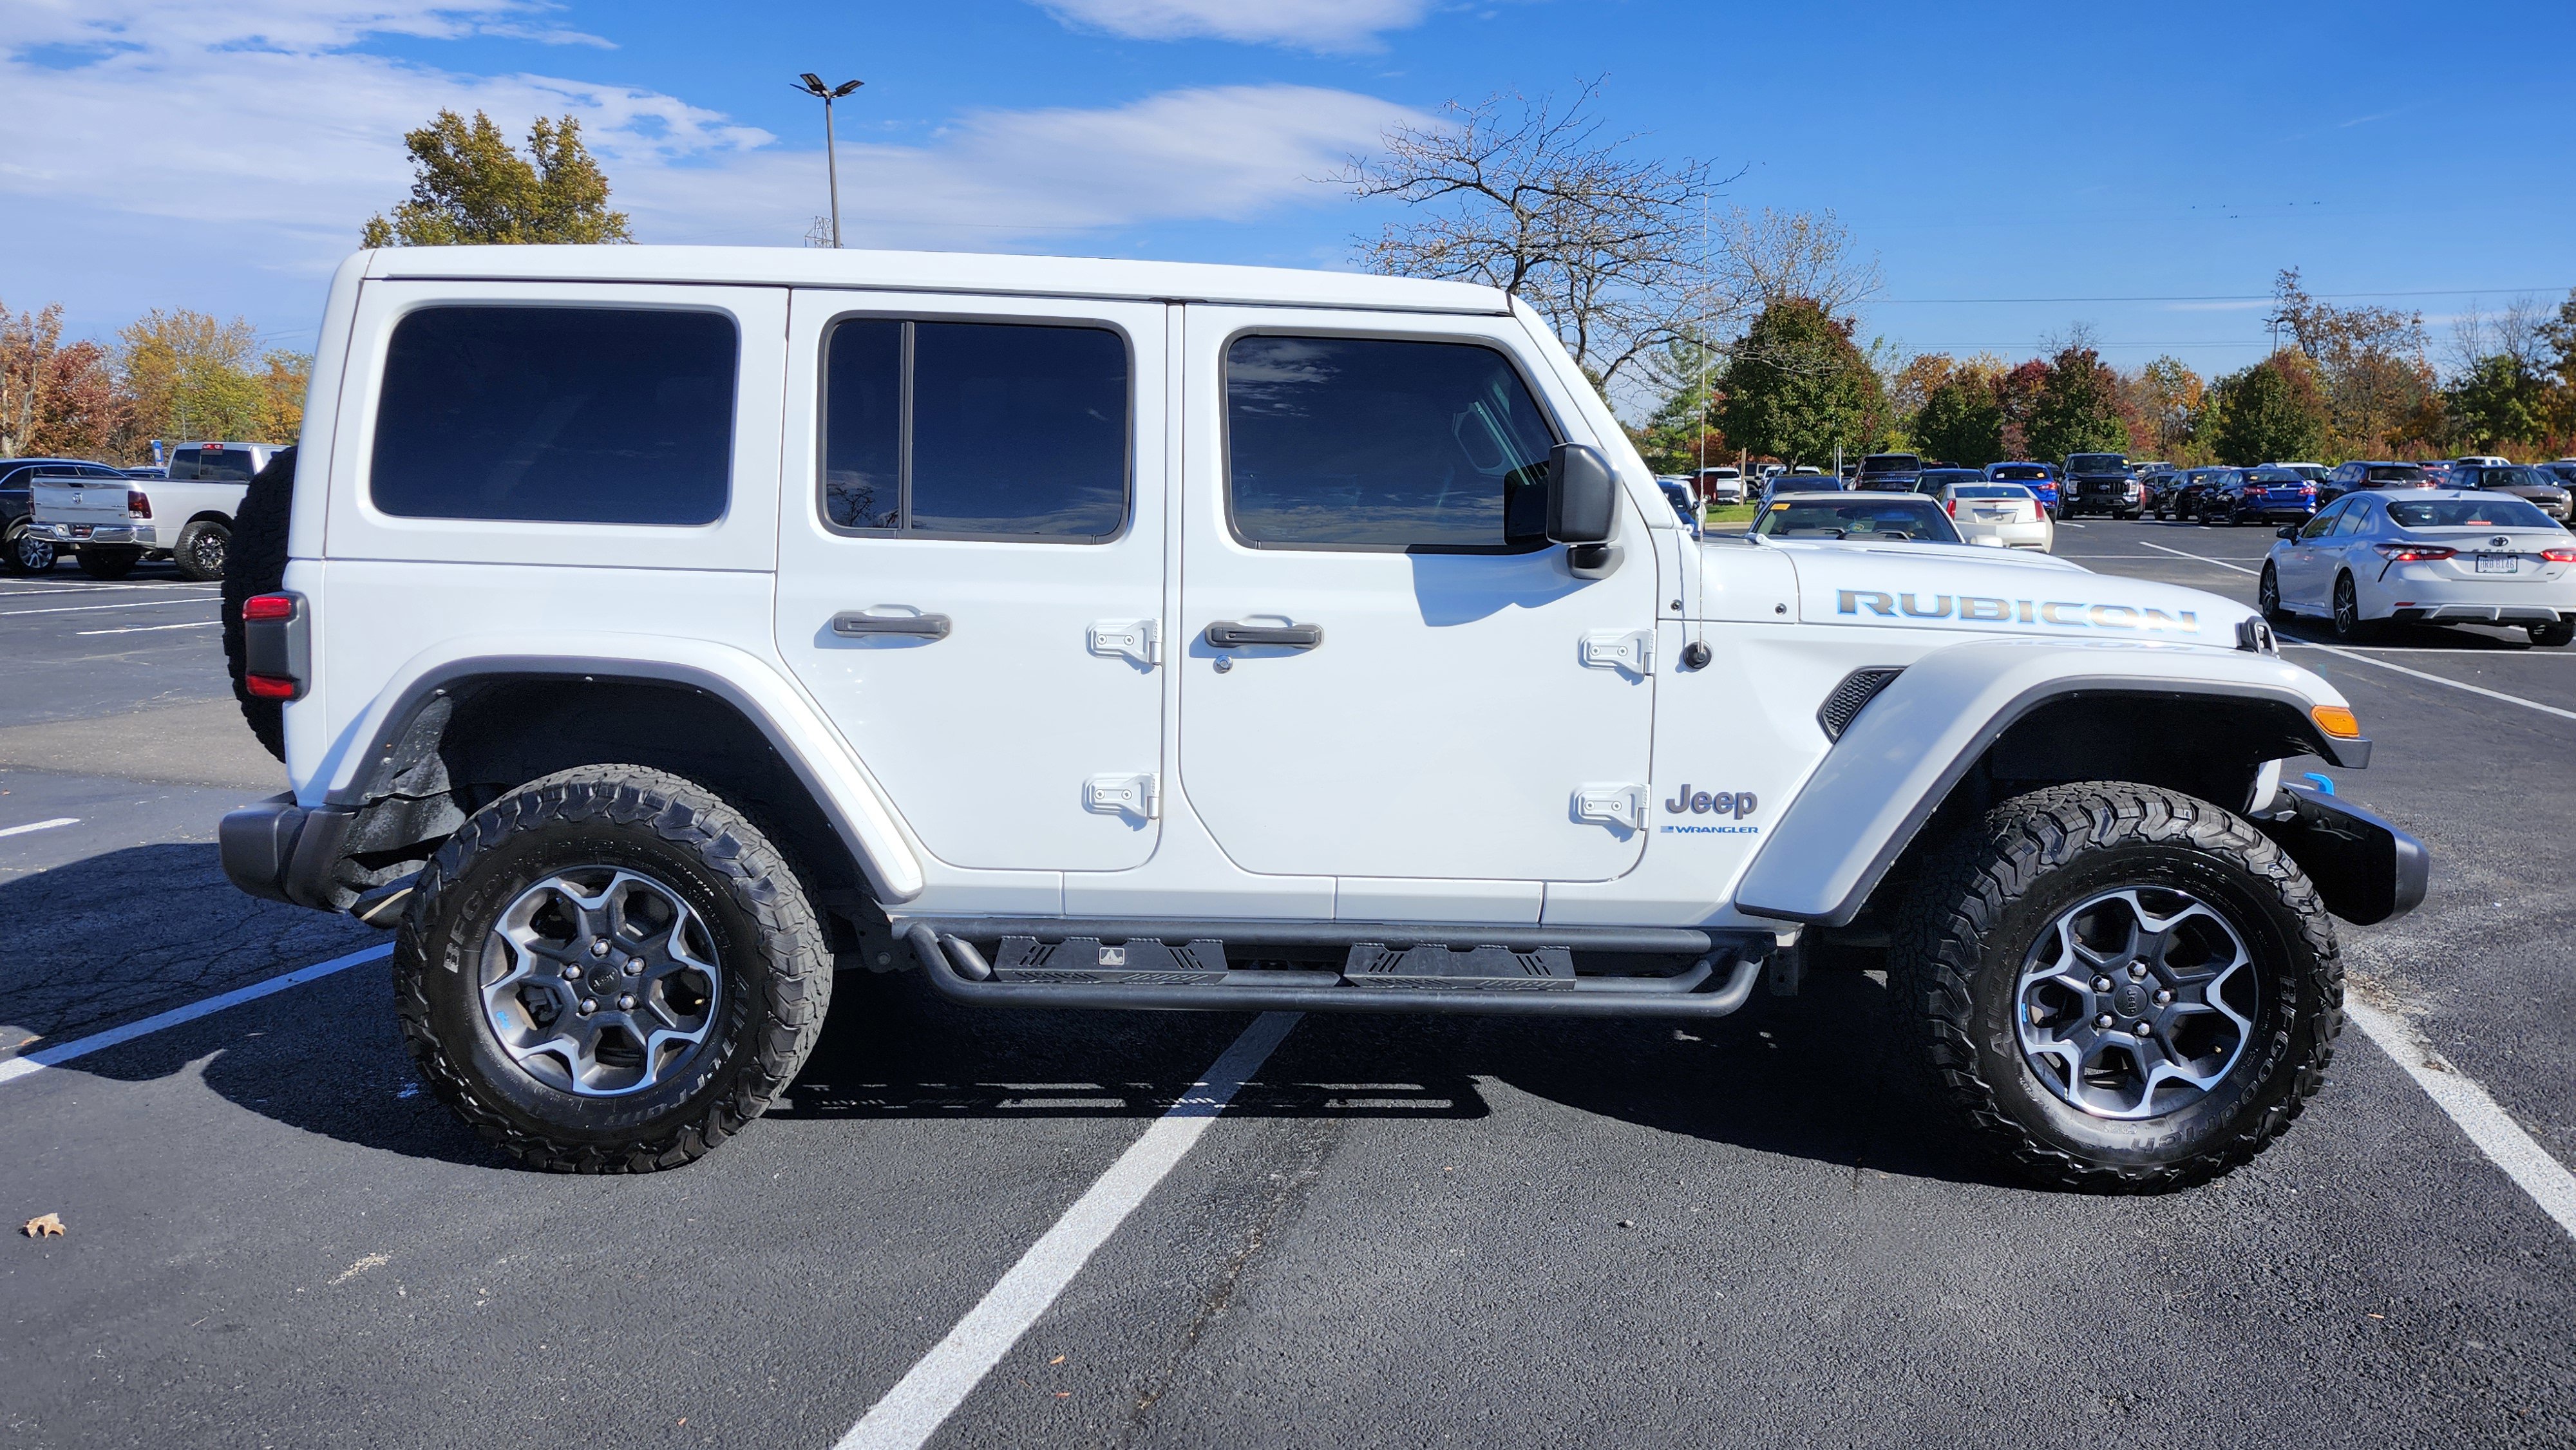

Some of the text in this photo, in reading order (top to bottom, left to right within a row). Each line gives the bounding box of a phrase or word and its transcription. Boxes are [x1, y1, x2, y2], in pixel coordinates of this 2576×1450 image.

[1836, 588, 2200, 634] RUBICON
[1665, 784, 1757, 820] Jeep
[1675, 825, 1759, 834] WRANGLER
[2126, 988, 2137, 1014] Jeep
